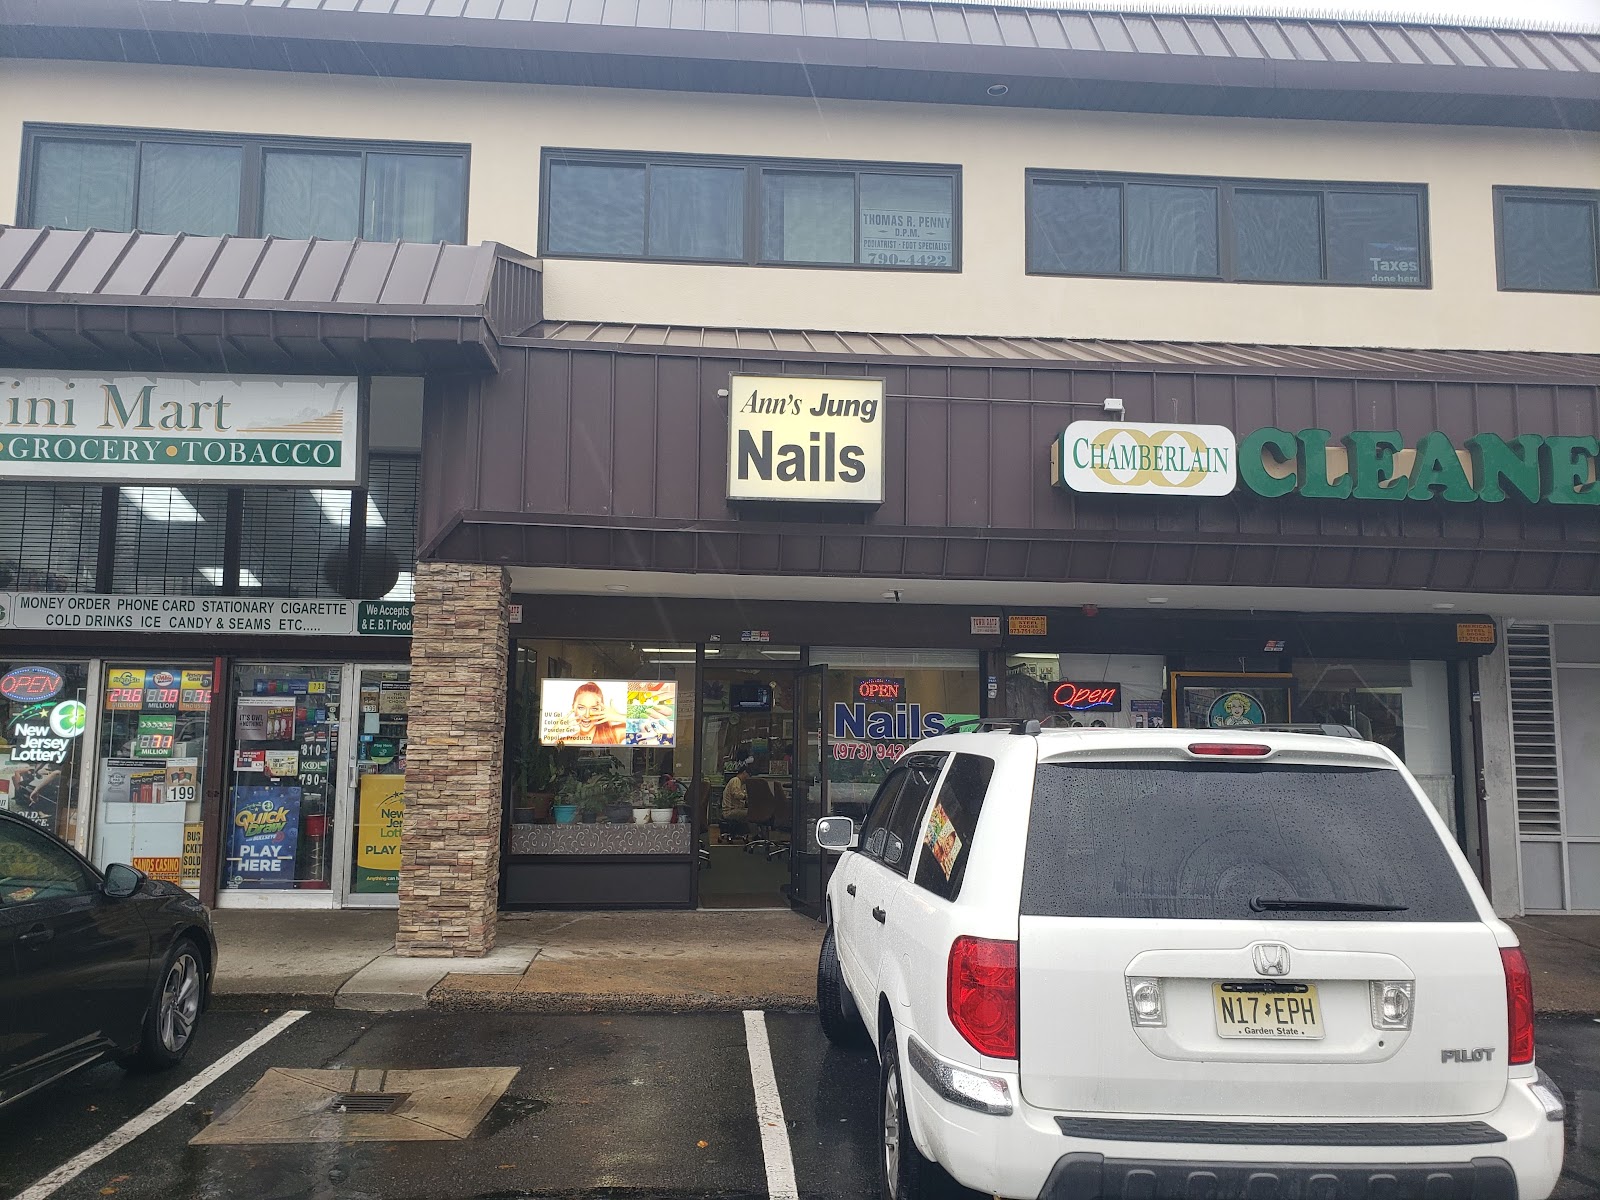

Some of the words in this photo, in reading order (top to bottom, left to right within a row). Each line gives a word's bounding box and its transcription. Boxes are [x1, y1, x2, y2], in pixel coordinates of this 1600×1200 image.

[863, 213, 904, 227] THOMAS
[906, 216, 916, 227] R.
[918, 216, 951, 229] PENNY
[895, 228, 920, 238] D.P.M.
[863, 240, 897, 249] PODIATRIST
[902, 241, 917, 250] FOOT
[918, 242, 951, 251] SPECIALIST
[868, 253, 947, 267] 790-4422
[1369, 257, 1418, 272] Taxes
[1371, 273, 1397, 282] done
[0, 380, 78, 429] ini
[97, 384, 233, 433] Mart
[740, 389, 803, 416] Ann's
[809, 393, 879, 424] Jung
[8, 436, 162, 463] GROCERY
[181, 440, 335, 466] TOBACCO
[737, 429, 866, 483] Nails
[1072, 437, 1229, 475] CHAMBERLAIN
[1238, 426, 1600, 505] CLEANE
[20, 596, 65, 609] MONEY
[67, 598, 111, 611] ORDER
[117, 598, 159, 612] PHONE
[162, 599, 196, 613] CARD
[201, 600, 275, 614] STATIONARY
[280, 602, 347, 615] CIGARETTE
[366, 603, 378, 616] We
[379, 604, 410, 618] Accepts
[46, 614, 81, 627] COLD
[86, 614, 133, 627] DRINKS
[140, 616, 161, 628] ICE
[169, 616, 212, 629] CANDY
[216, 617, 225, 629] &
[228, 617, 272, 630] SEAMS
[392, 619, 412, 631] Food
[0, 676, 61, 693] OPEN
[859, 684, 900, 698] OPEN
[1053, 683, 1117, 708] Open
[833, 702, 947, 740] Nails
[14, 723, 50, 737] New
[20, 736, 70, 752] Jersey
[11, 747, 68, 764] Lottery
[832, 743, 873, 761] (973)
[876, 743, 905, 761] 942
[301, 761, 323, 769] KOOL
[186, 831, 201, 842] BUS
[245, 821, 287, 837] Draw
[240, 845, 282, 857] PLAY
[365, 845, 397, 855] PLAY
[133, 858, 155, 872] SANDS
[155, 858, 179, 872] CASINO
[183, 855, 201, 866] SOLD
[237, 859, 282, 872] HERE
[182, 868, 201, 878] HERE
[1220, 996, 1259, 1024] N17
[1273, 997, 1316, 1025] EPH
[1244, 1026, 1274, 1035] Garden
[1276, 1027, 1299, 1036] State
[1441, 1047, 1496, 1064] PILOT
